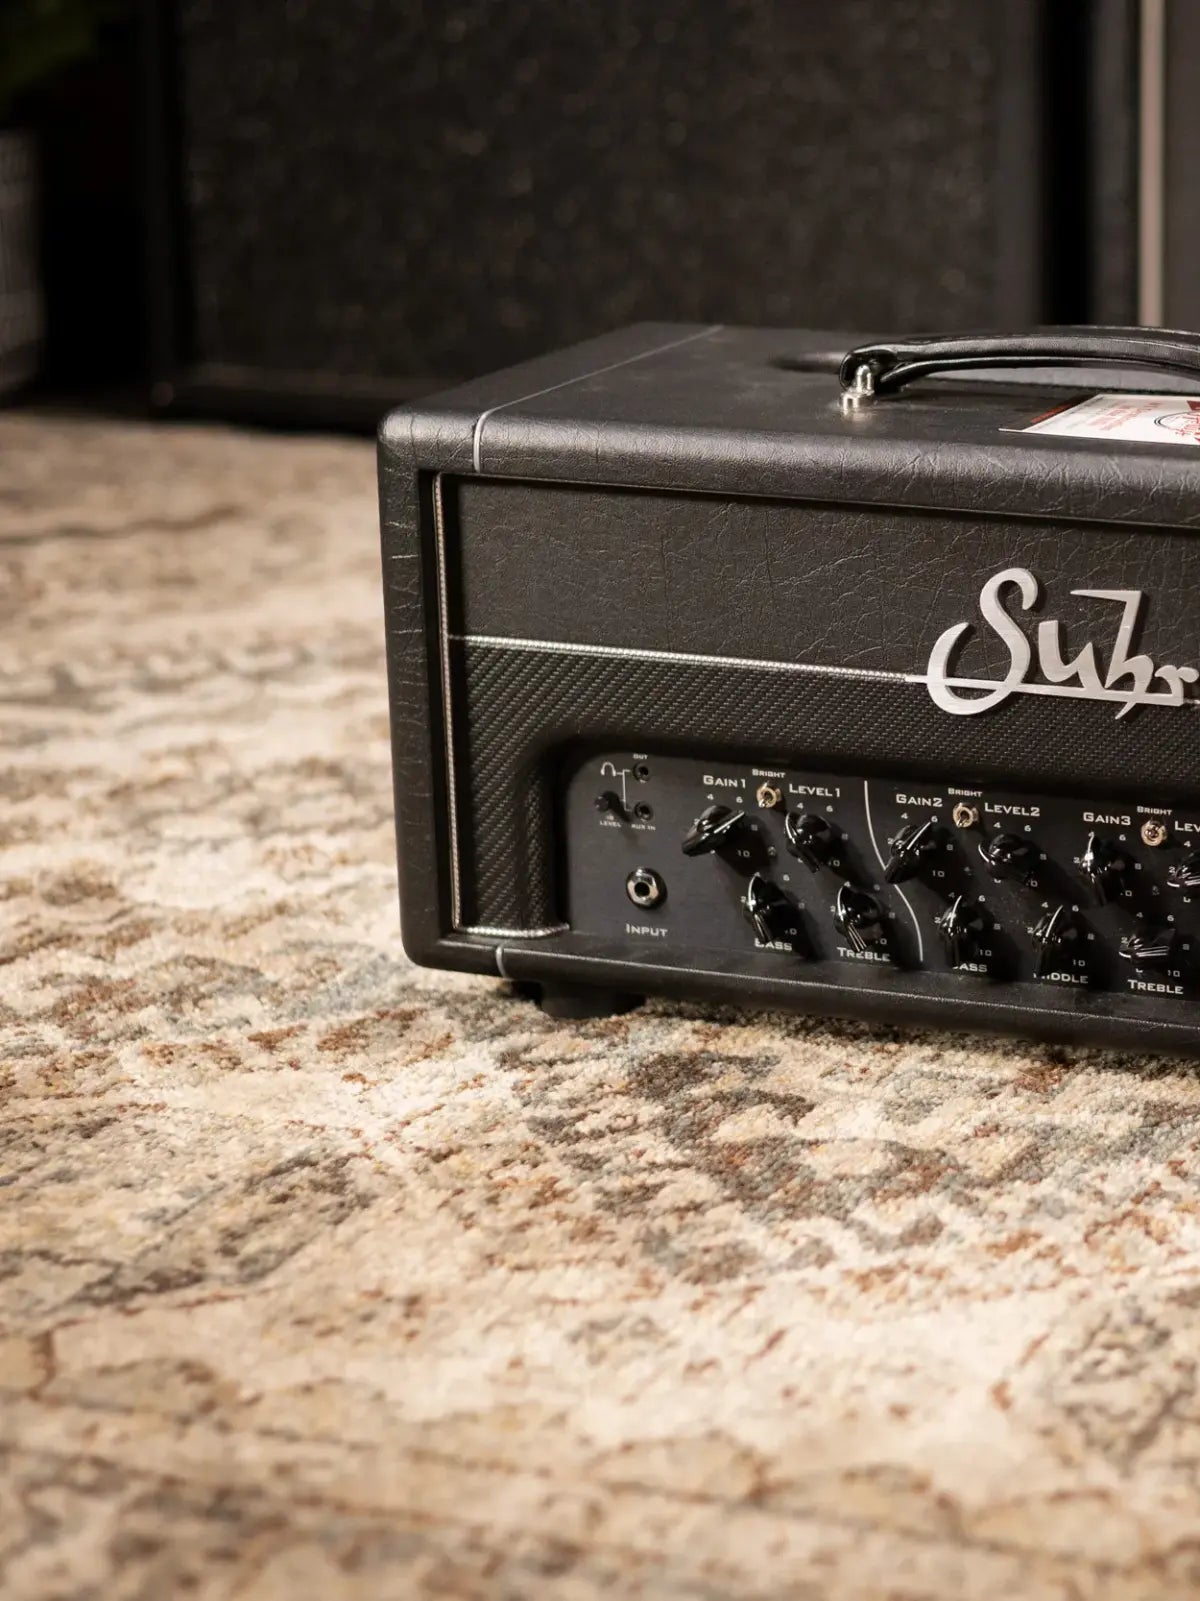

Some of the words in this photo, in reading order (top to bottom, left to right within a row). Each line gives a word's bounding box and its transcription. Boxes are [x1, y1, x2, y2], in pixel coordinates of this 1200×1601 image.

[927, 567, 1199, 720] Suhr
[752, 768, 786, 779] BRIGHT
[948, 788, 983, 797] BRIGHT
[1137, 805, 1172, 816] BRIGHT
[625, 923, 668, 937] INPUT
[952, 963, 988, 973] ASS
[1033, 972, 1089, 984] DDLE
[1127, 979, 1184, 995] TREBLE
